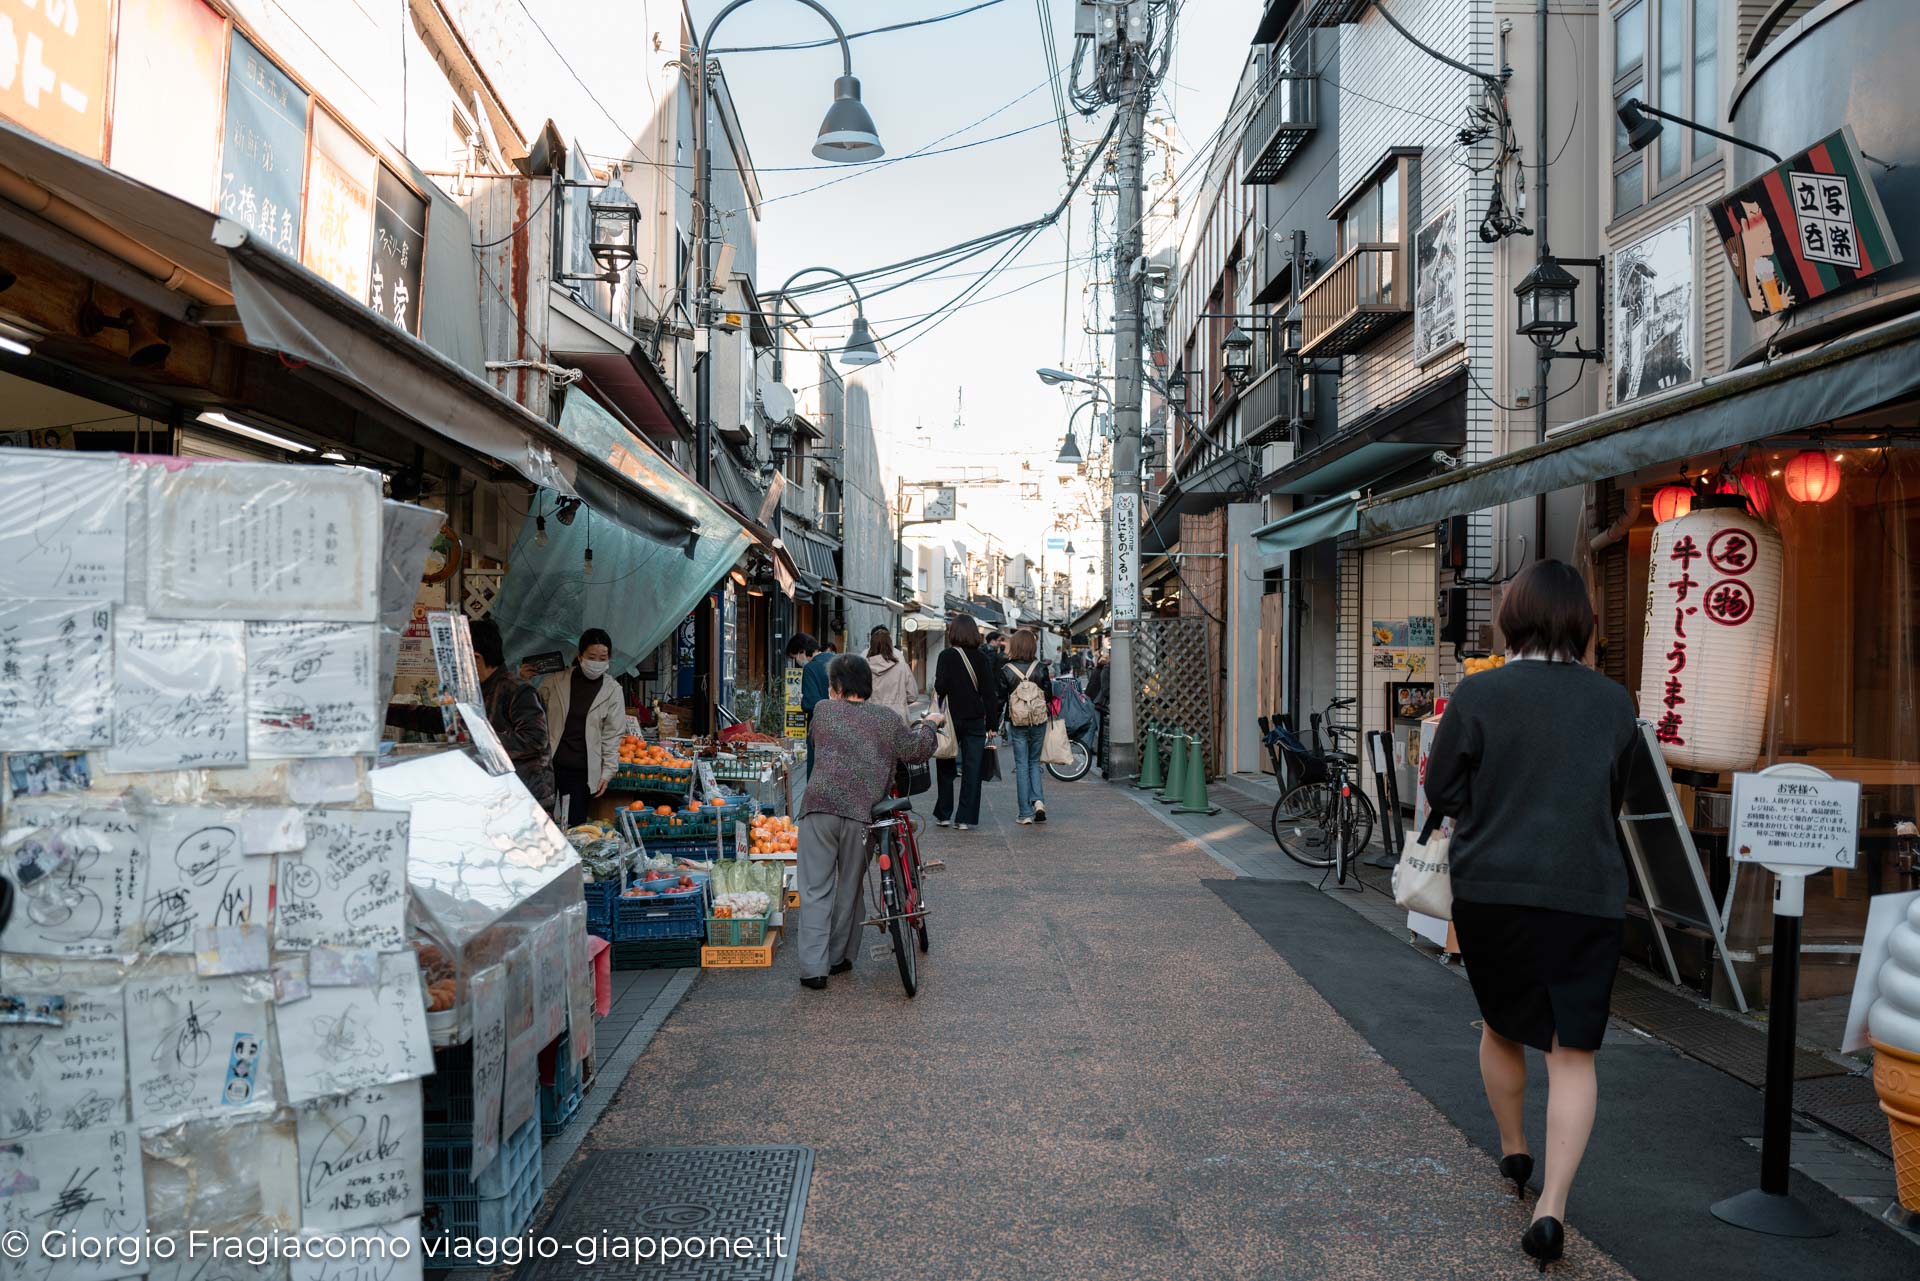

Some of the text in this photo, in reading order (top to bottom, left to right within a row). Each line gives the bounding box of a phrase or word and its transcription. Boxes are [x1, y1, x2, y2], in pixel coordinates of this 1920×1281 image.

[220, 173, 294, 256] 石橋鮮魚
[1797, 182, 1826, 252] 立呑
[1823, 185, 1852, 257] 写楽
[1118, 512, 1129, 581] しにものぐるい
[1708, 533, 1752, 622] 名物
[1656, 535, 1702, 746] 牛すじうま煮
[1777, 784, 1819, 795] お客様へ
